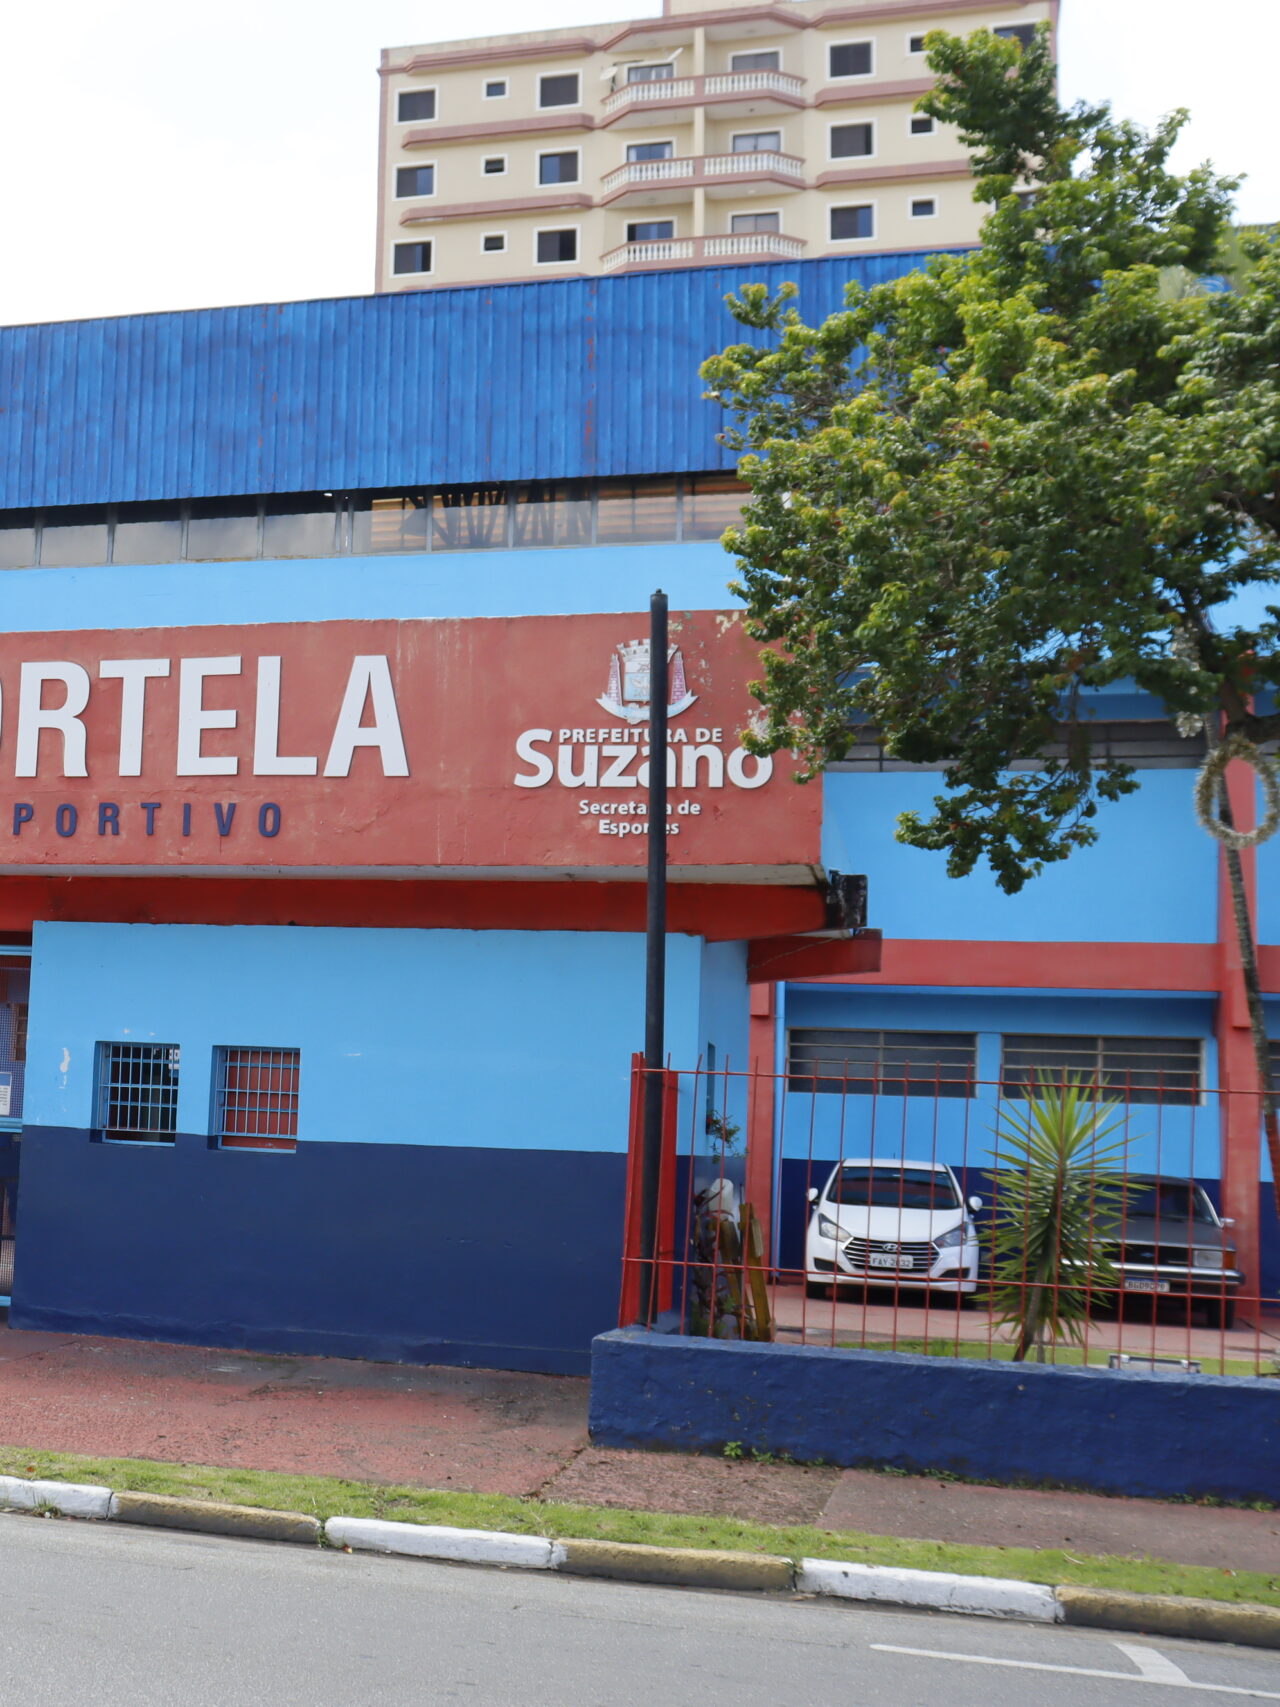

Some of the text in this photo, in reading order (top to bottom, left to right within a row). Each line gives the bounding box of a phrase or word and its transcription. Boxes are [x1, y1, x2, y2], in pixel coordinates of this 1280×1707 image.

[695, 727, 723, 743] DE
[578, 799, 702, 815] Secretaa de
[598, 819, 680, 838] Espors
